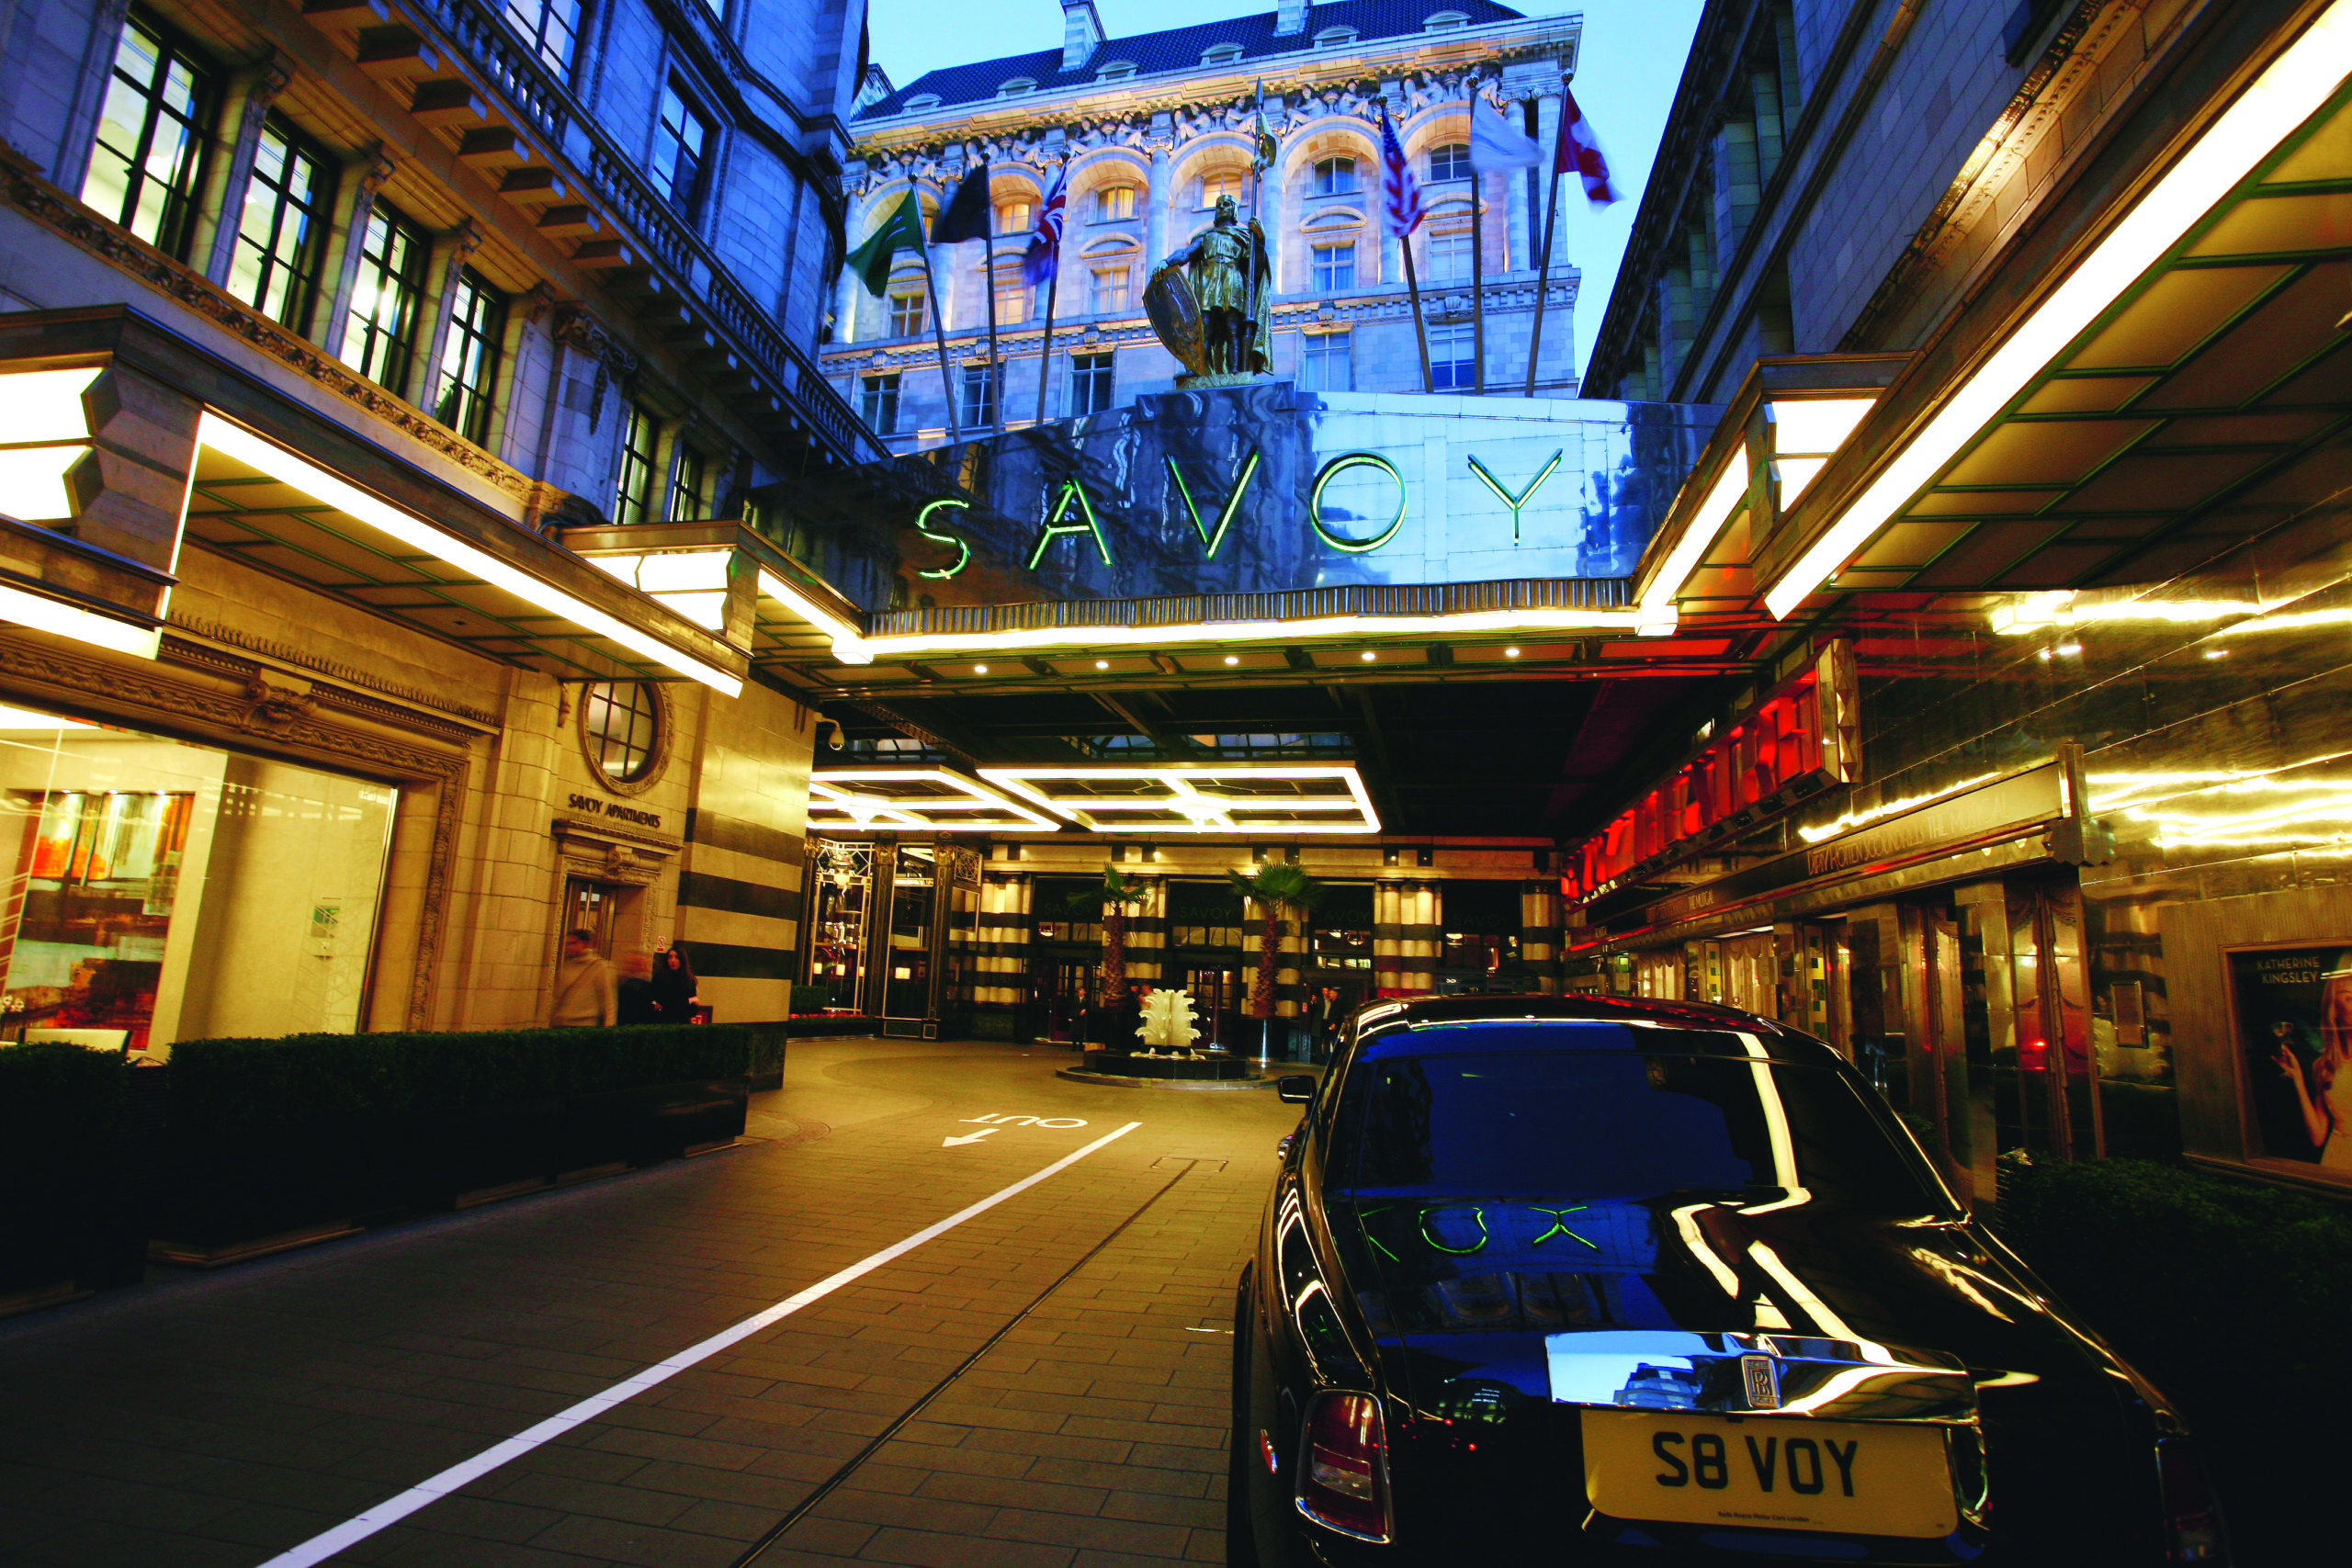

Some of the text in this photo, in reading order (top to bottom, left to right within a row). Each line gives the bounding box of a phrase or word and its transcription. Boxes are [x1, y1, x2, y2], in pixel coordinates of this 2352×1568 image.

[915, 448, 1563, 581] SAVOY
[568, 793, 661, 828] SAVOY APARTMENTS
[1314, 909, 1370, 923] AVOY
[2256, 956, 2321, 971] KATHERINE
[2260, 971, 2318, 985] KINGSLEY
[958, 1113, 1088, 1129] OUT
[1652, 1430, 1858, 1497] S8 VOY
